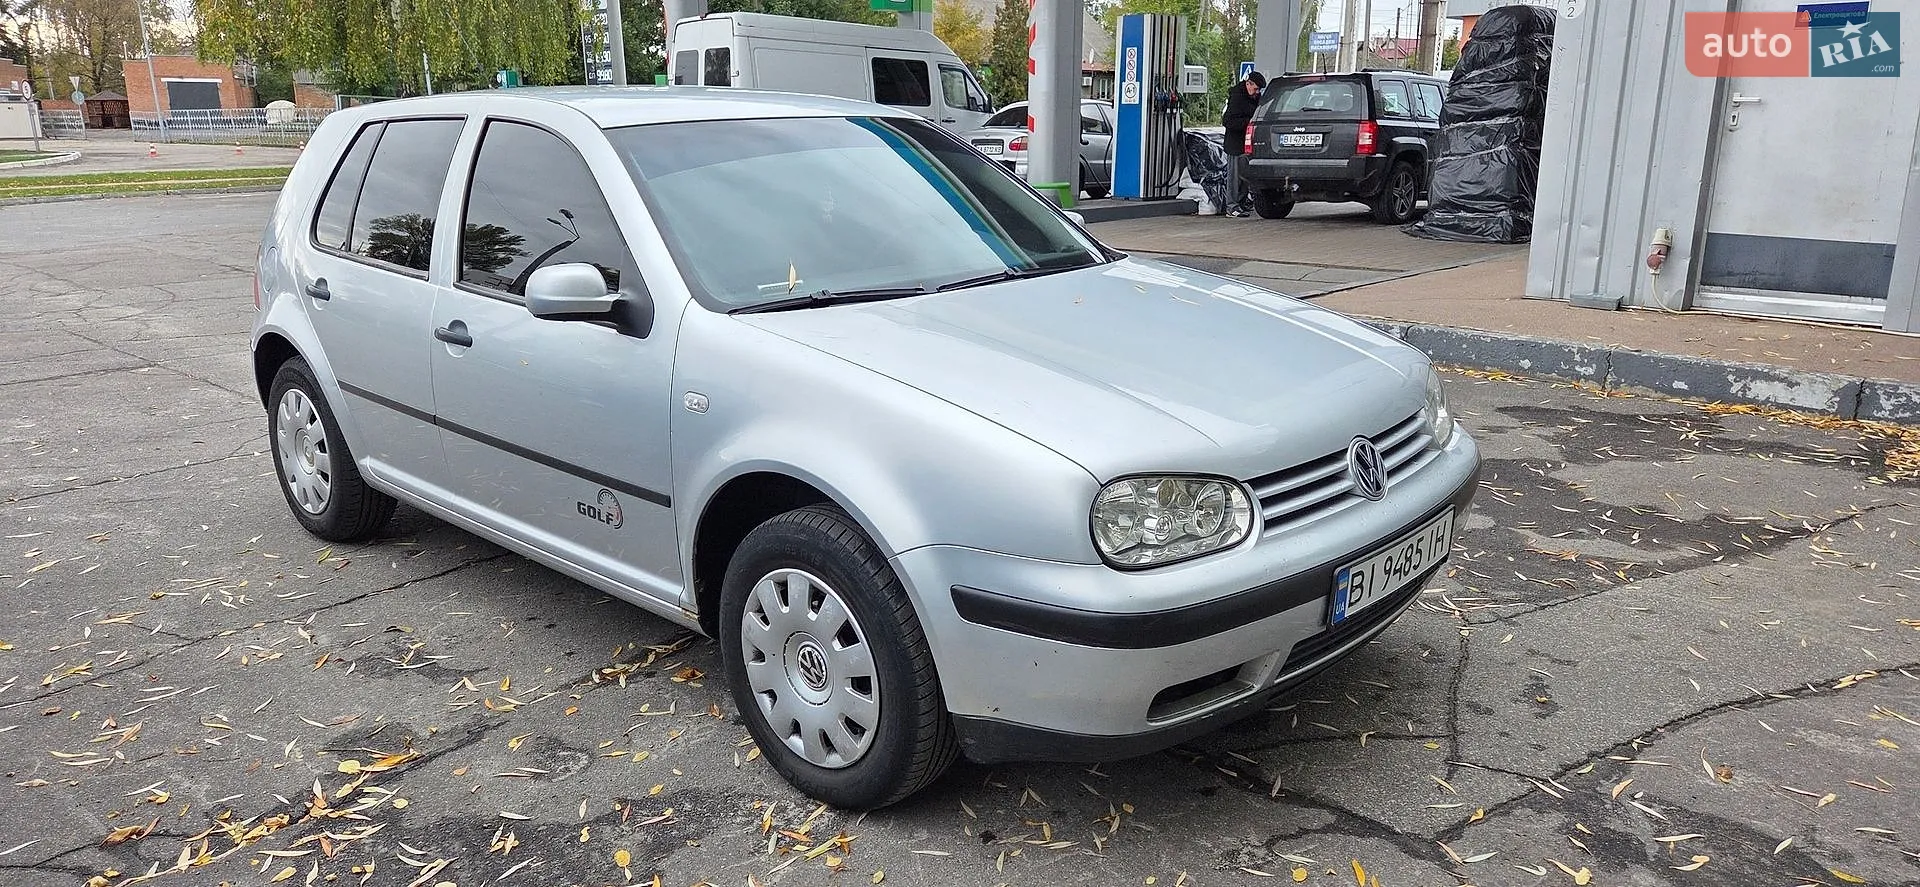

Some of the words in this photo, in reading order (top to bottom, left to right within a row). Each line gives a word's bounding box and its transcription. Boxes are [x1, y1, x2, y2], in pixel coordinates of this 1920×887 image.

[1567, 6, 1575, 17] 2
[1813, 10, 1866, 19] Електрощитова
[1293, 135, 1309, 143] 4795
[577, 501, 614, 525] GOLF
[1348, 563, 1375, 608] BI
[1381, 536, 1424, 591] 9485
[1427, 520, 1447, 561] IH
[1335, 601, 1345, 615] UA
